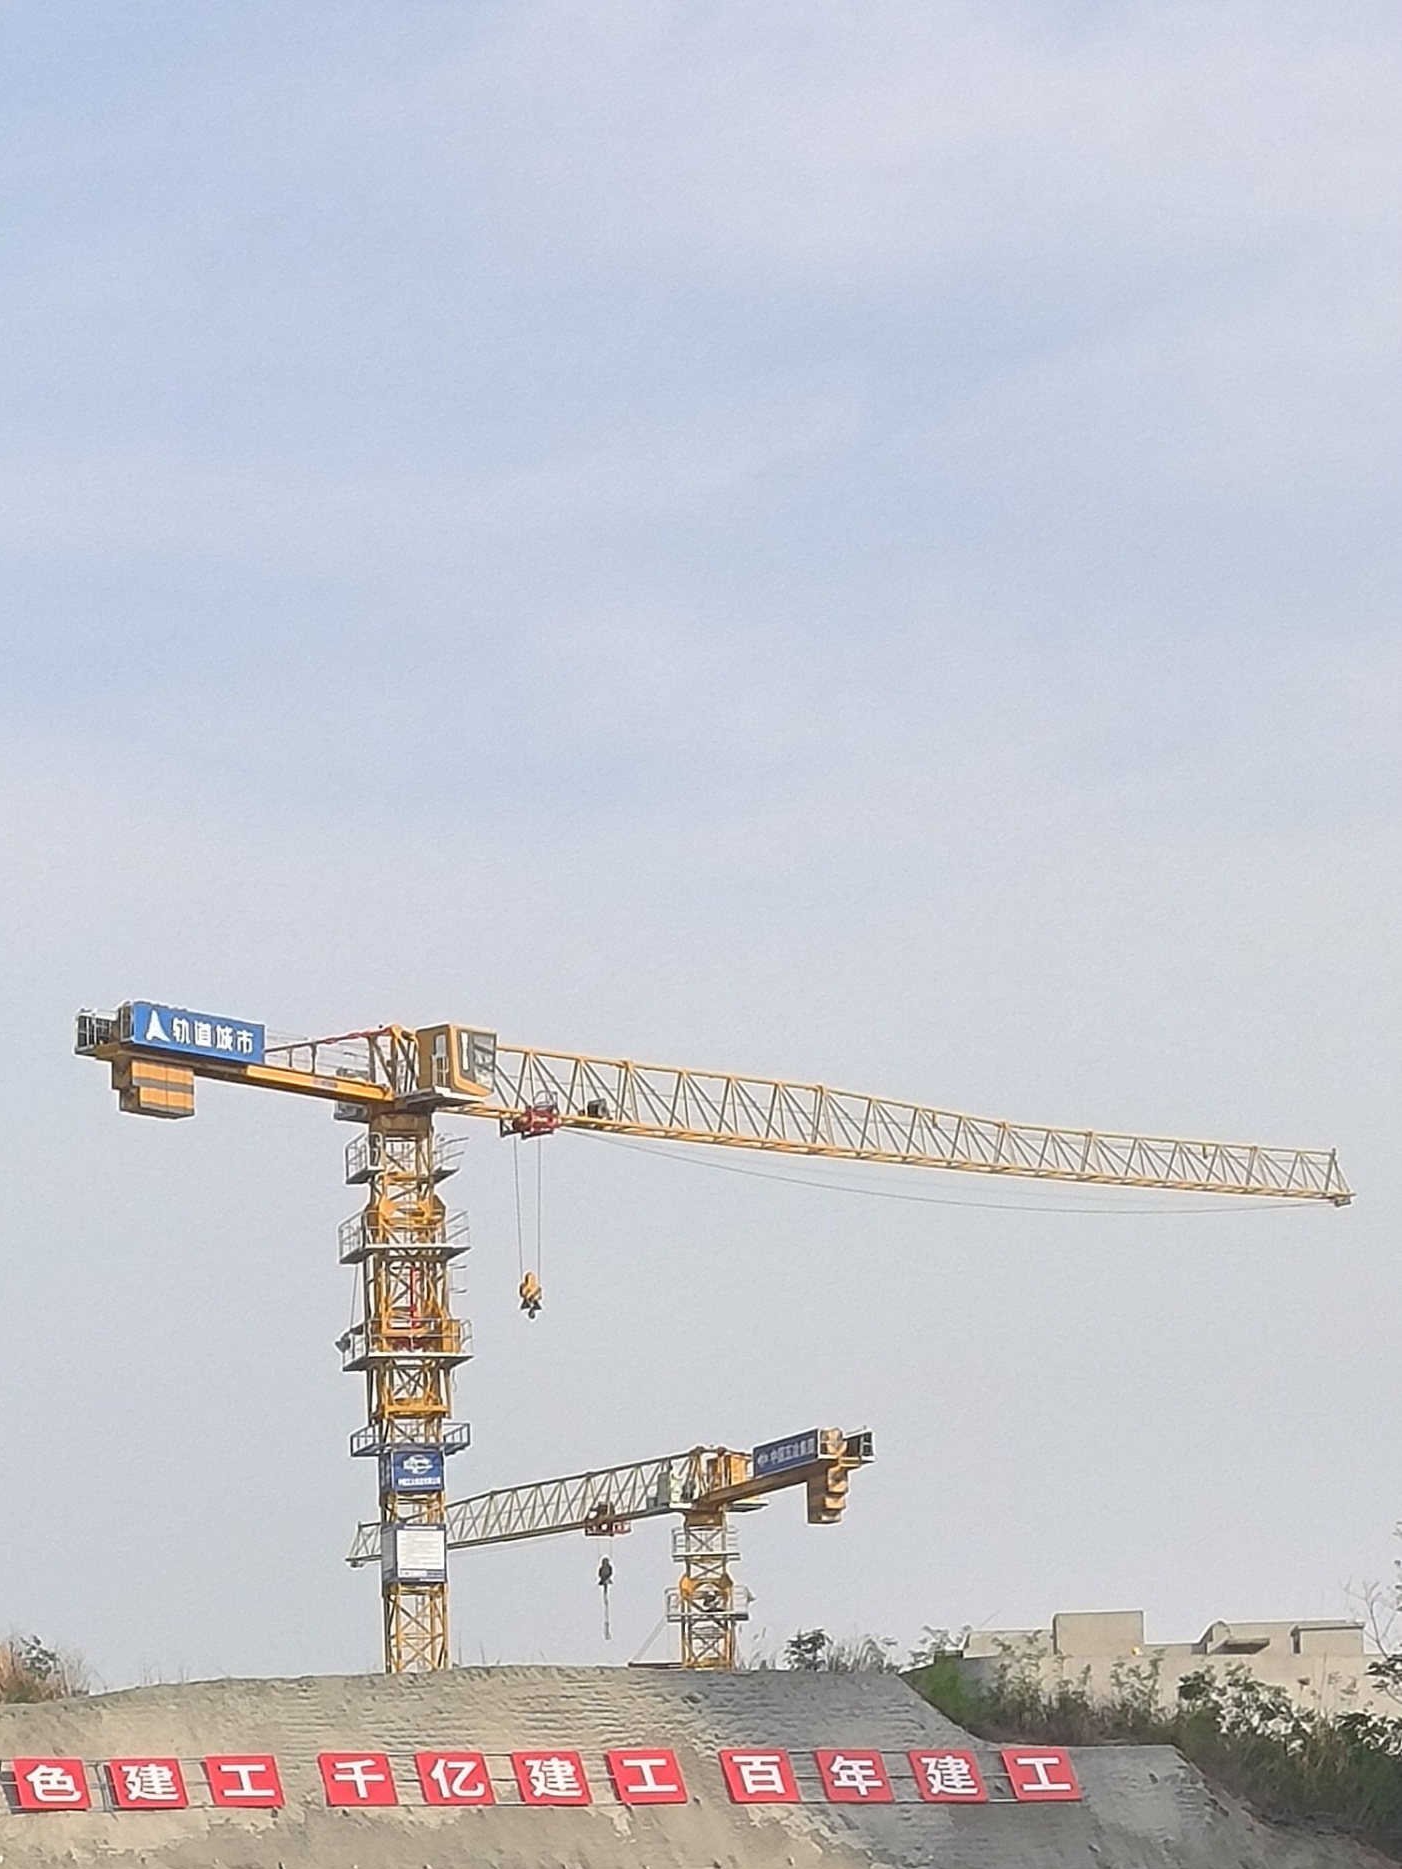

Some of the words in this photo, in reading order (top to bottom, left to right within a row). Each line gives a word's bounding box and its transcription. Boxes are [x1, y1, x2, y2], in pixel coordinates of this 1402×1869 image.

[171, 1017, 255, 1056] 轨道城市
[332, 1757, 679, 1799] 千亿建工
[731, 1753, 1073, 1797] 百年建工
